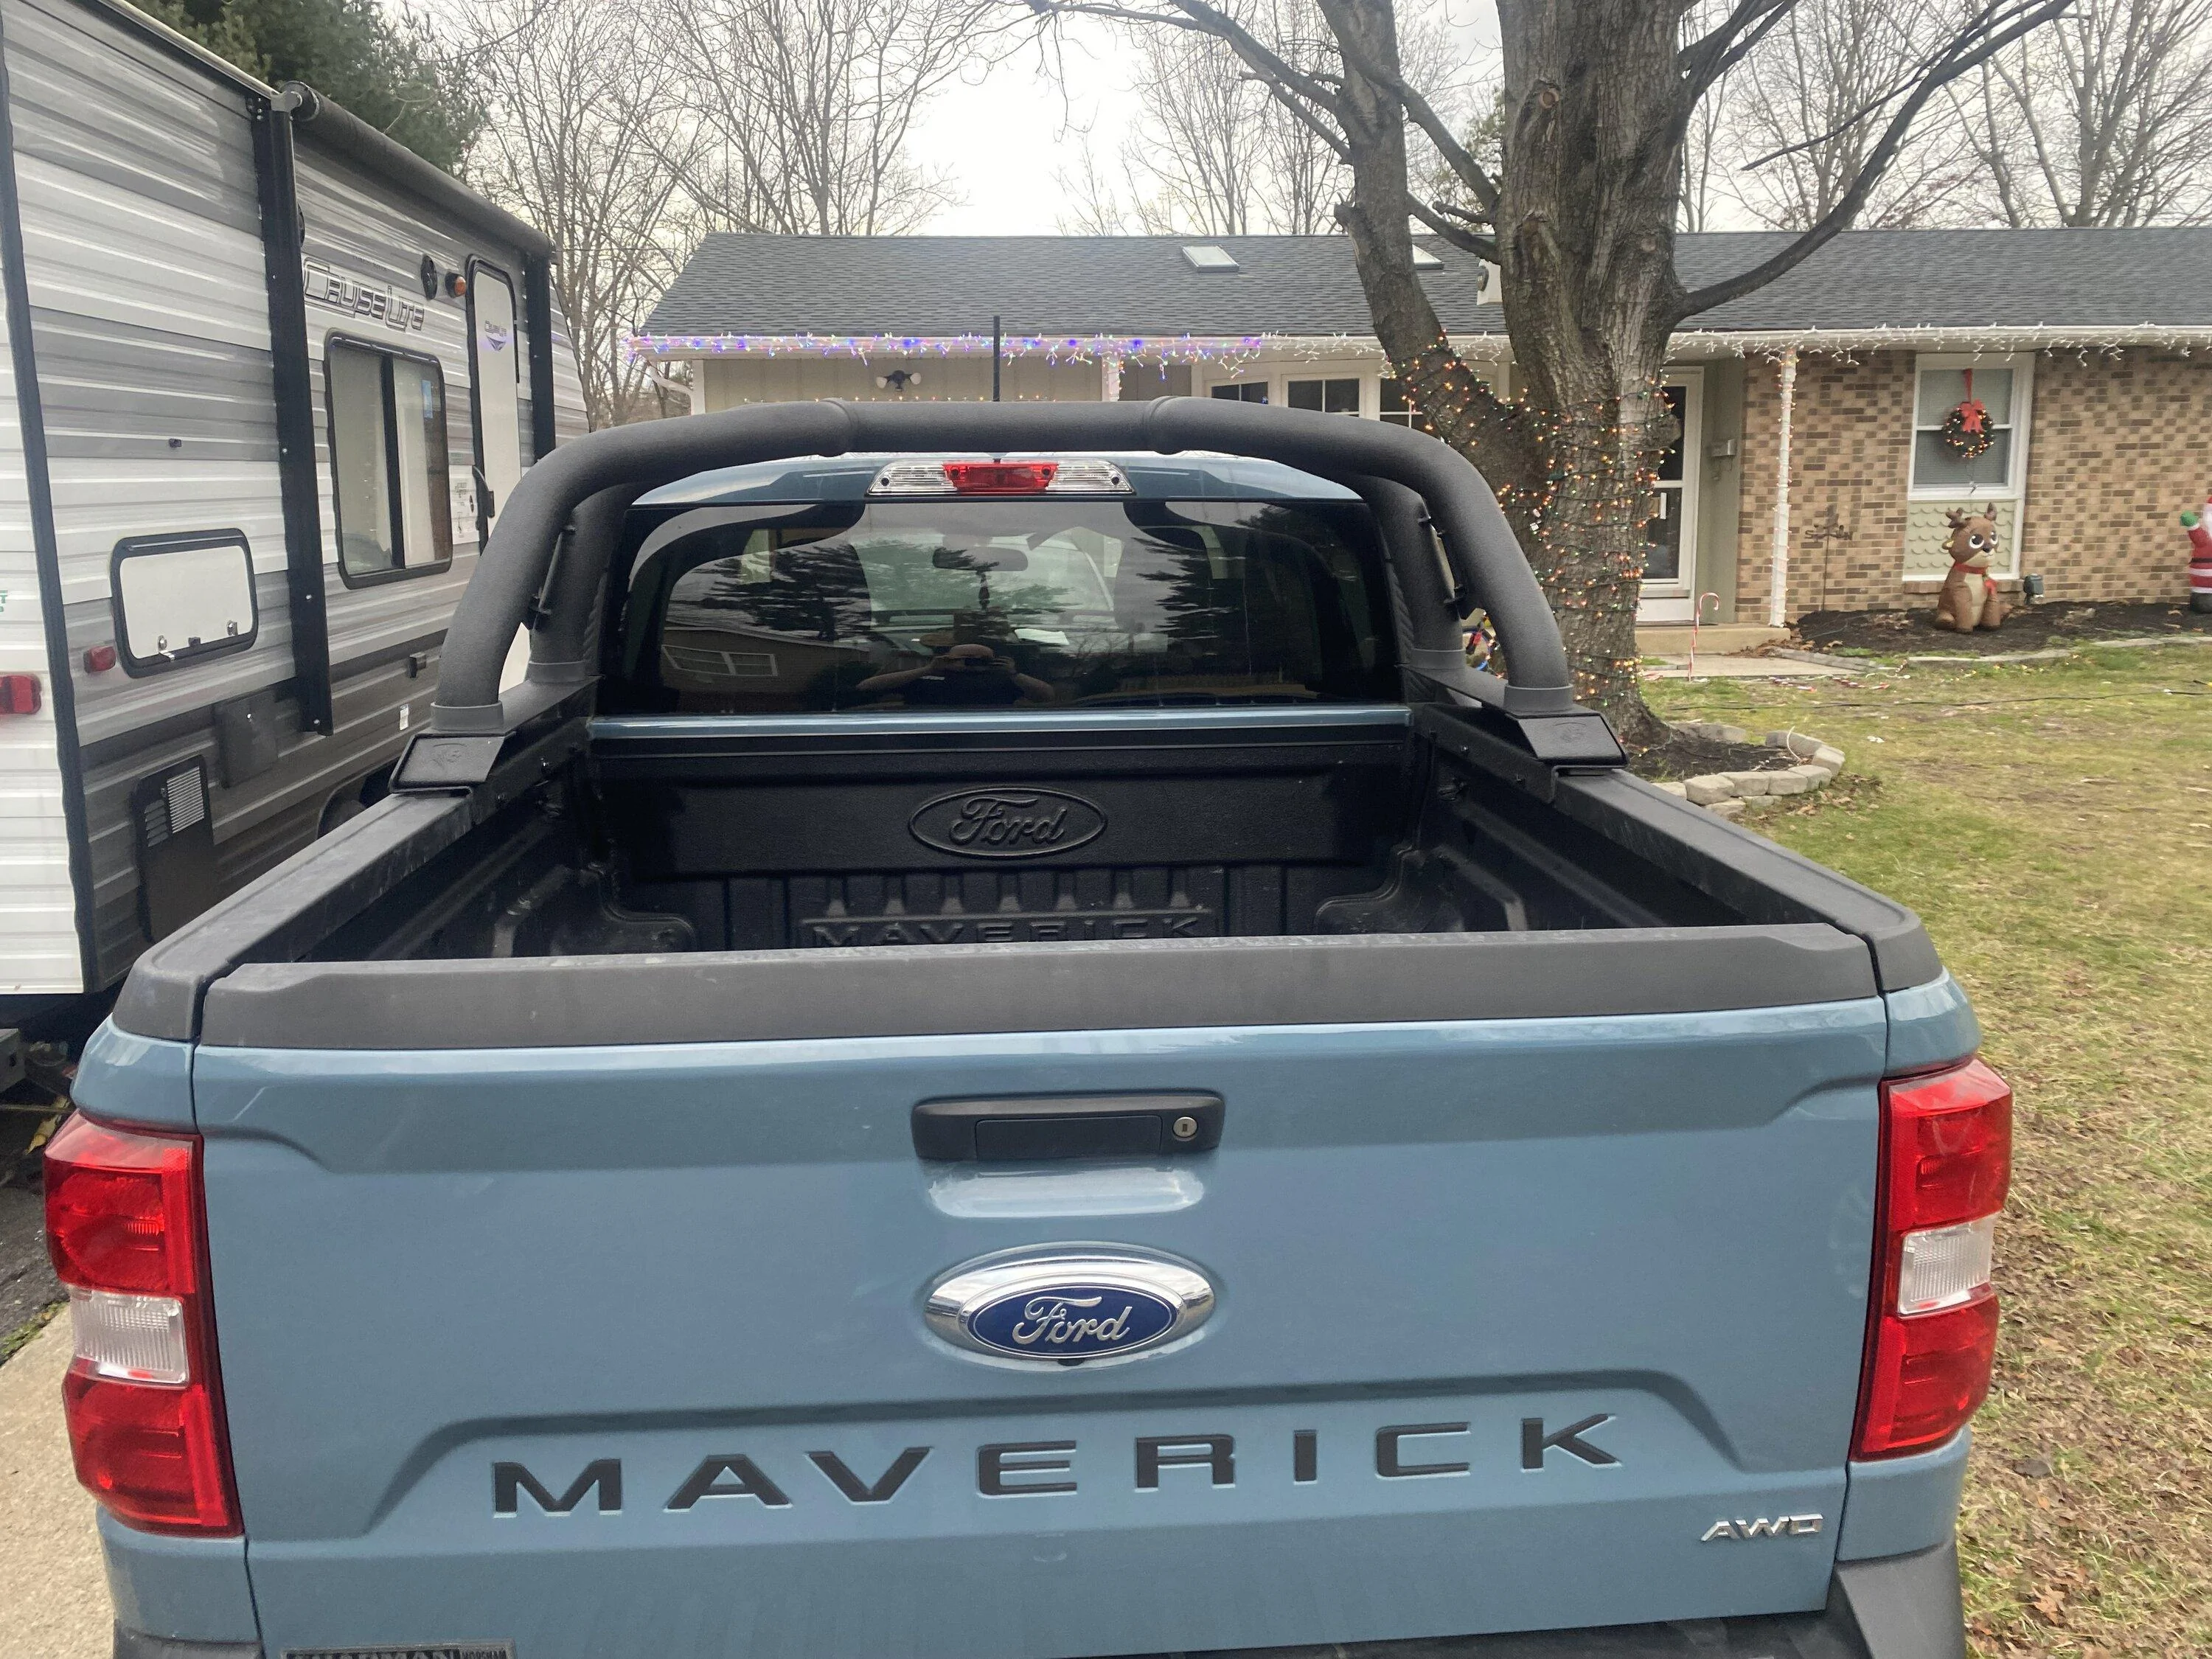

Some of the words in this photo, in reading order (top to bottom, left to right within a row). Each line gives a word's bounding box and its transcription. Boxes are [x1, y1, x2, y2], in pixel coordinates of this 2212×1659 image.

[949, 796, 1068, 846] Ford
[813, 917, 1199, 946] MAVERICK
[1012, 1295, 1133, 1345] Ford
[493, 1413, 1623, 1519] MAVERICK
[1700, 1513, 1824, 1543] AWD
